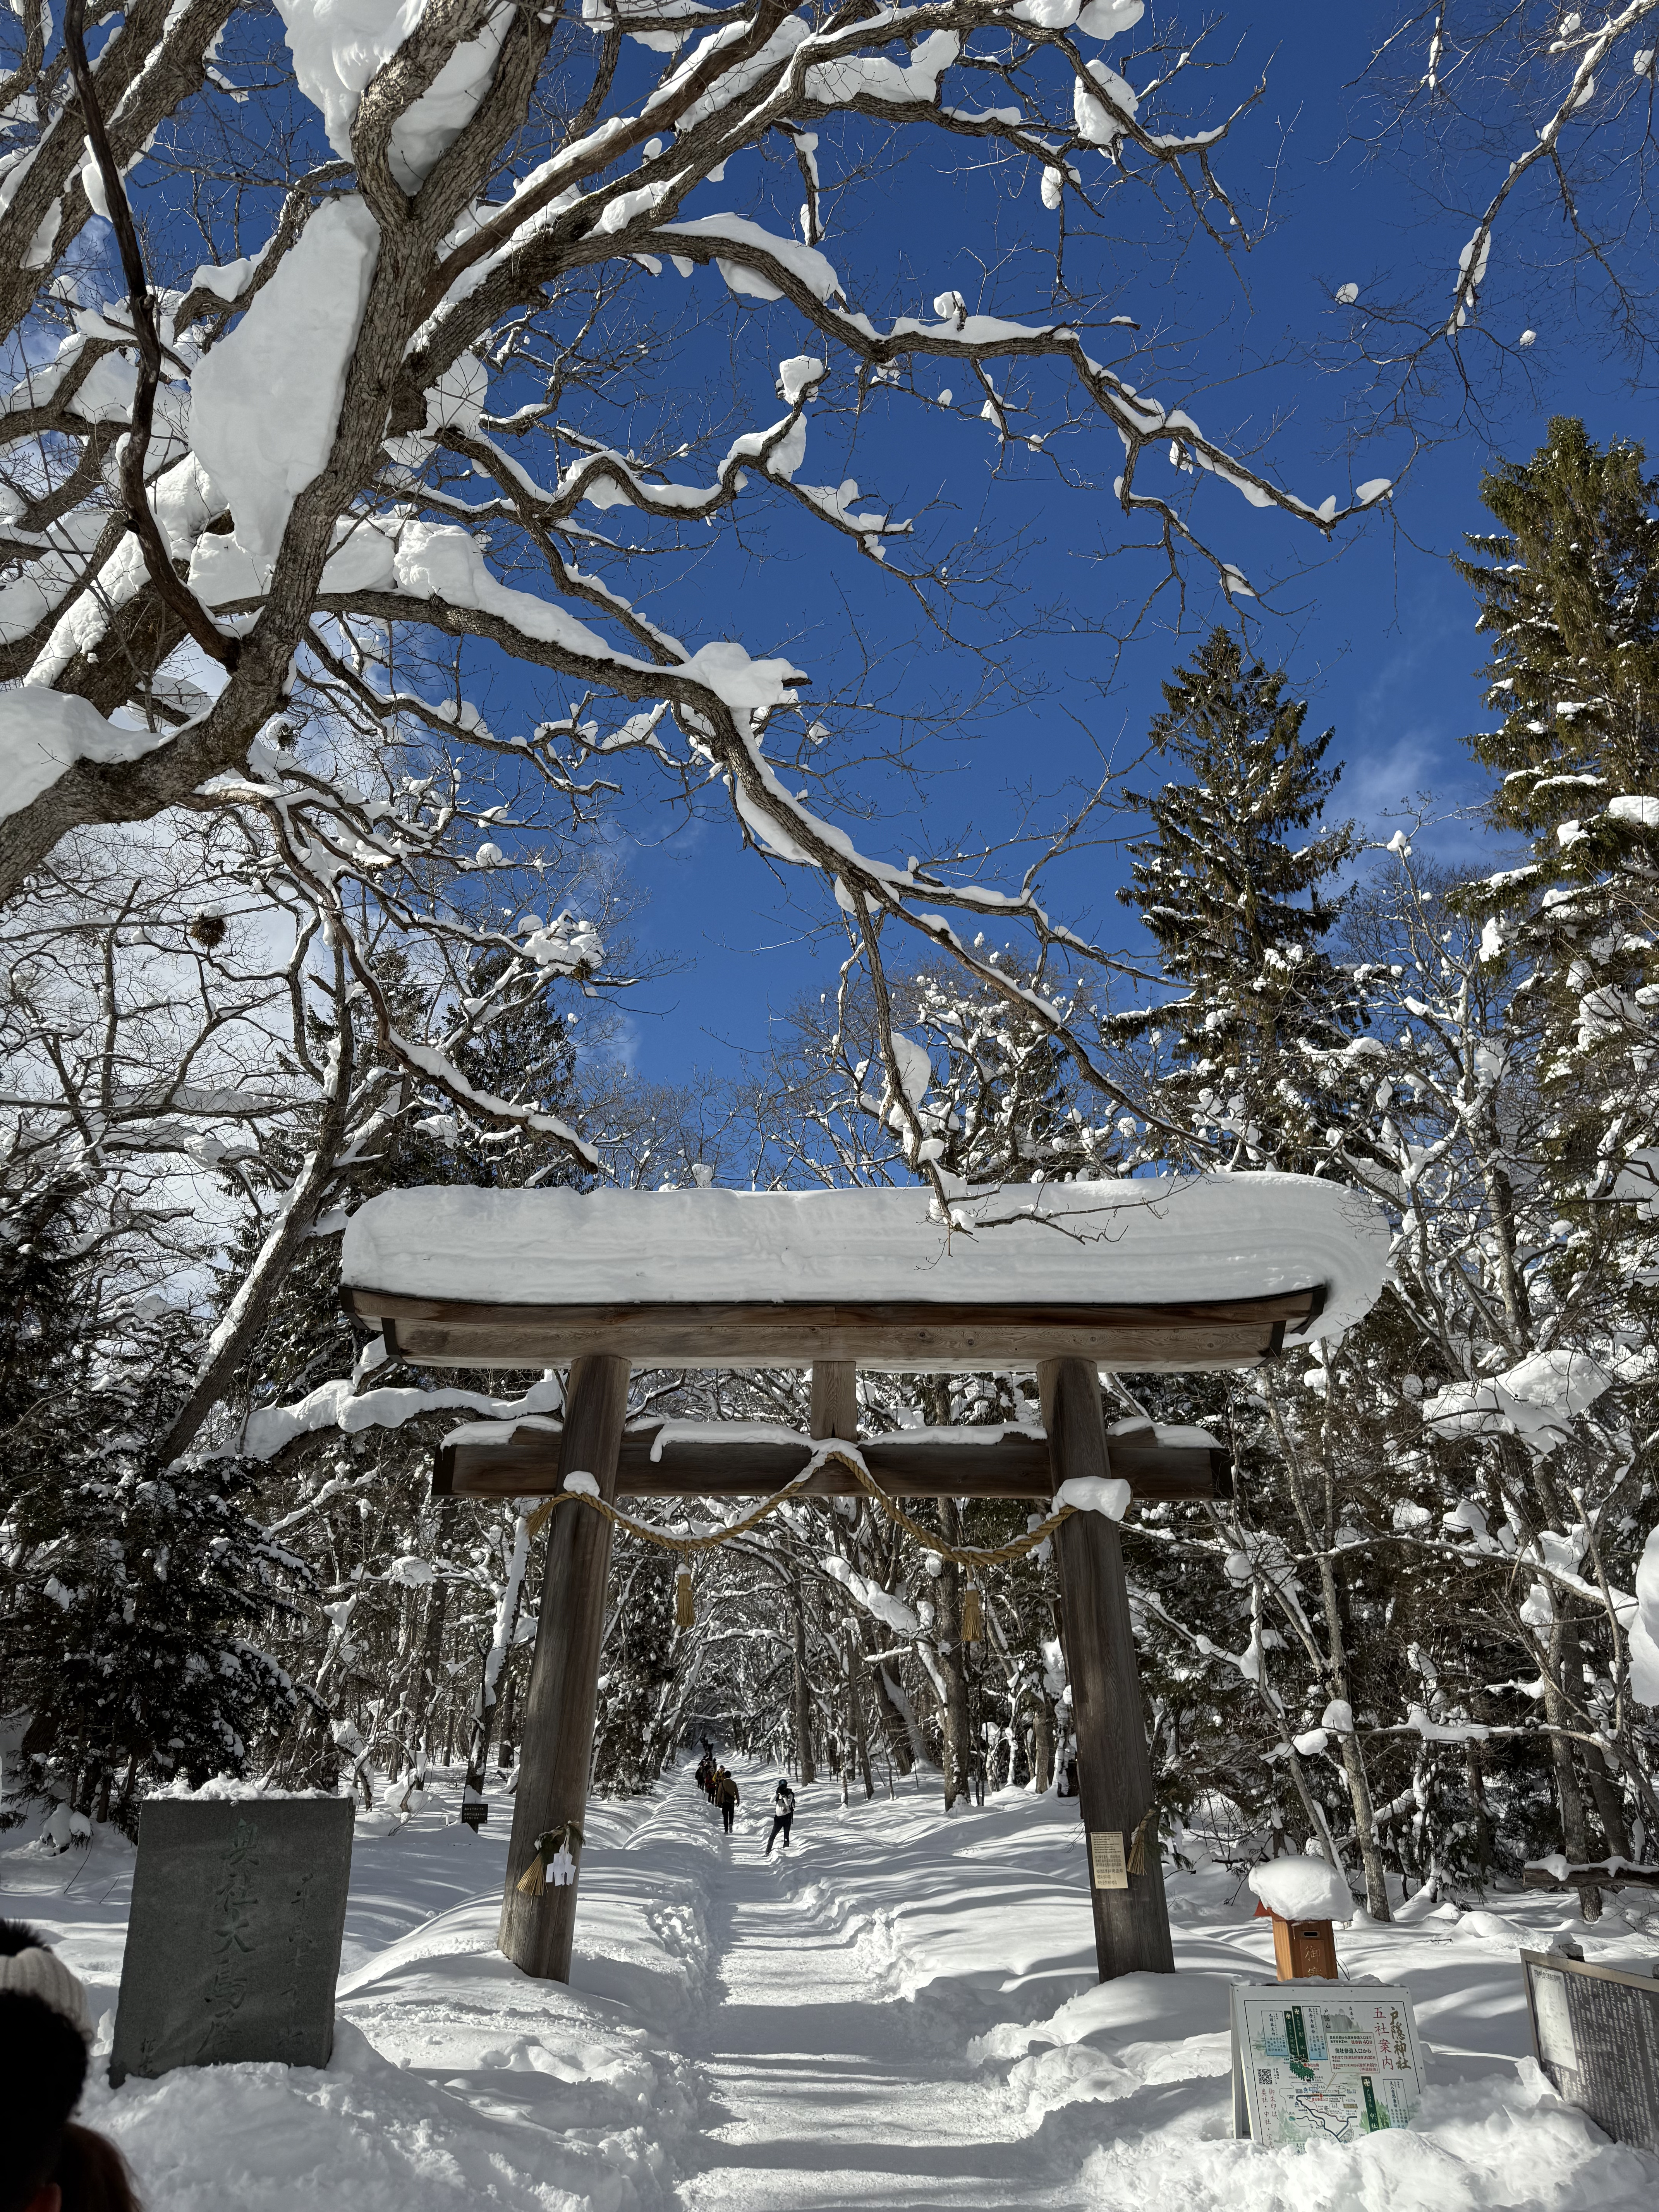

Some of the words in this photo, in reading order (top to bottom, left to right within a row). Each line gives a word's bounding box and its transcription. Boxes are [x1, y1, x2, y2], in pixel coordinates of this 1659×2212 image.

[1373, 2007, 1394, 2071] 五社案内
[1390, 2006, 1412, 2070] 戸隠神社
